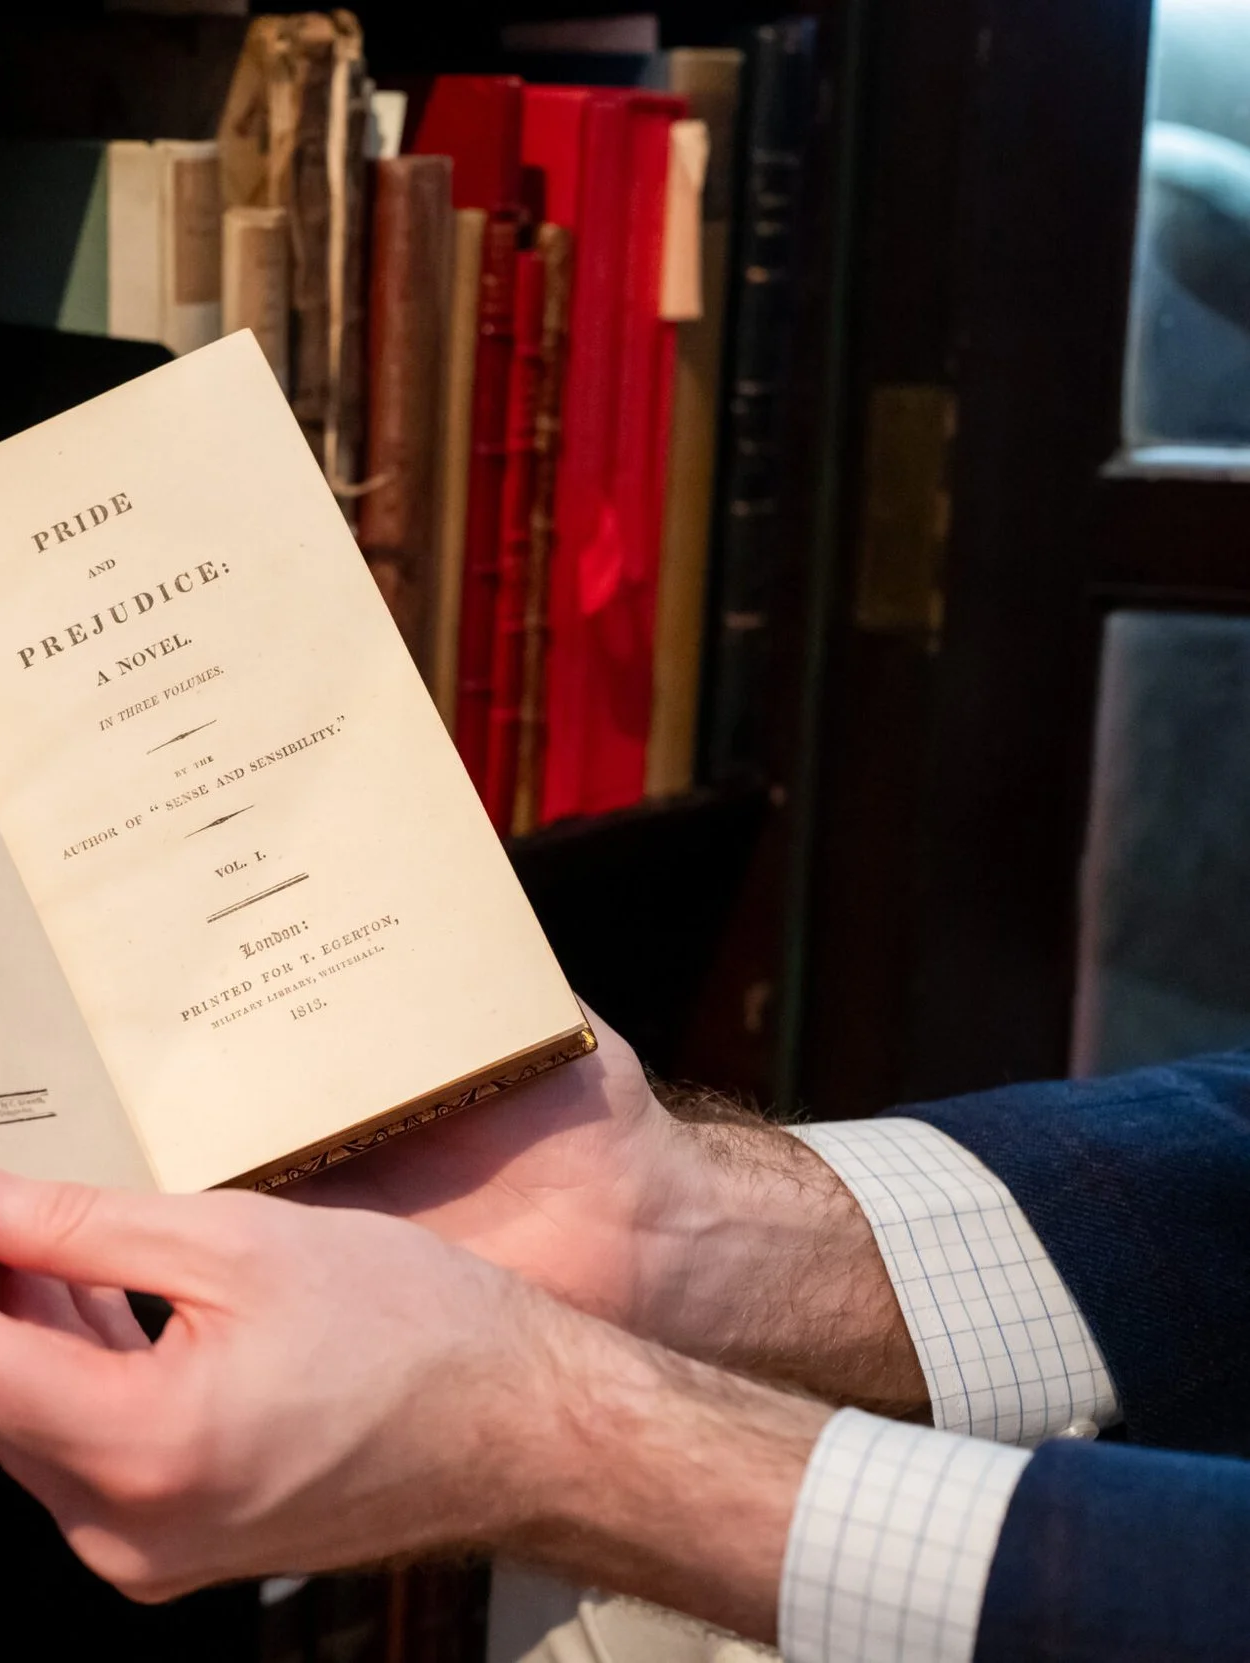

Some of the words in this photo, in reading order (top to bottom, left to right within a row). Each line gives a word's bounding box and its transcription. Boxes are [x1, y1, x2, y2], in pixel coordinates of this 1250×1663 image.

[30, 493, 133, 554] PRIDE
[88, 558, 116, 579] AND
[16, 560, 230, 670] PREJUDICE:
[97, 670, 111, 687] A
[115, 634, 193, 676] NOVEL.
[99, 716, 114, 732] IN
[117, 695, 160, 722] THREE
[162, 665, 225, 701] VOLUMES.
[173, 767, 187, 778] BY
[194, 755, 215, 769] THE
[63, 827, 119, 860] AUTHOR
[125, 814, 143, 829] OF
[217, 767, 245, 789] AND
[214, 860, 248, 878] VOL.
[238, 920, 309, 960] London:
[179, 980, 253, 1023] PRINTED
[261, 962, 294, 984] FOR
[299, 953, 316, 965] T.
[320, 915, 400, 956] EGERTON,
[210, 999, 263, 1030] MILITARY
[266, 976, 317, 1004] LIBRARY,
[317, 945, 385, 978] WHITEHALL.
[289, 997, 328, 1021] 1813.
